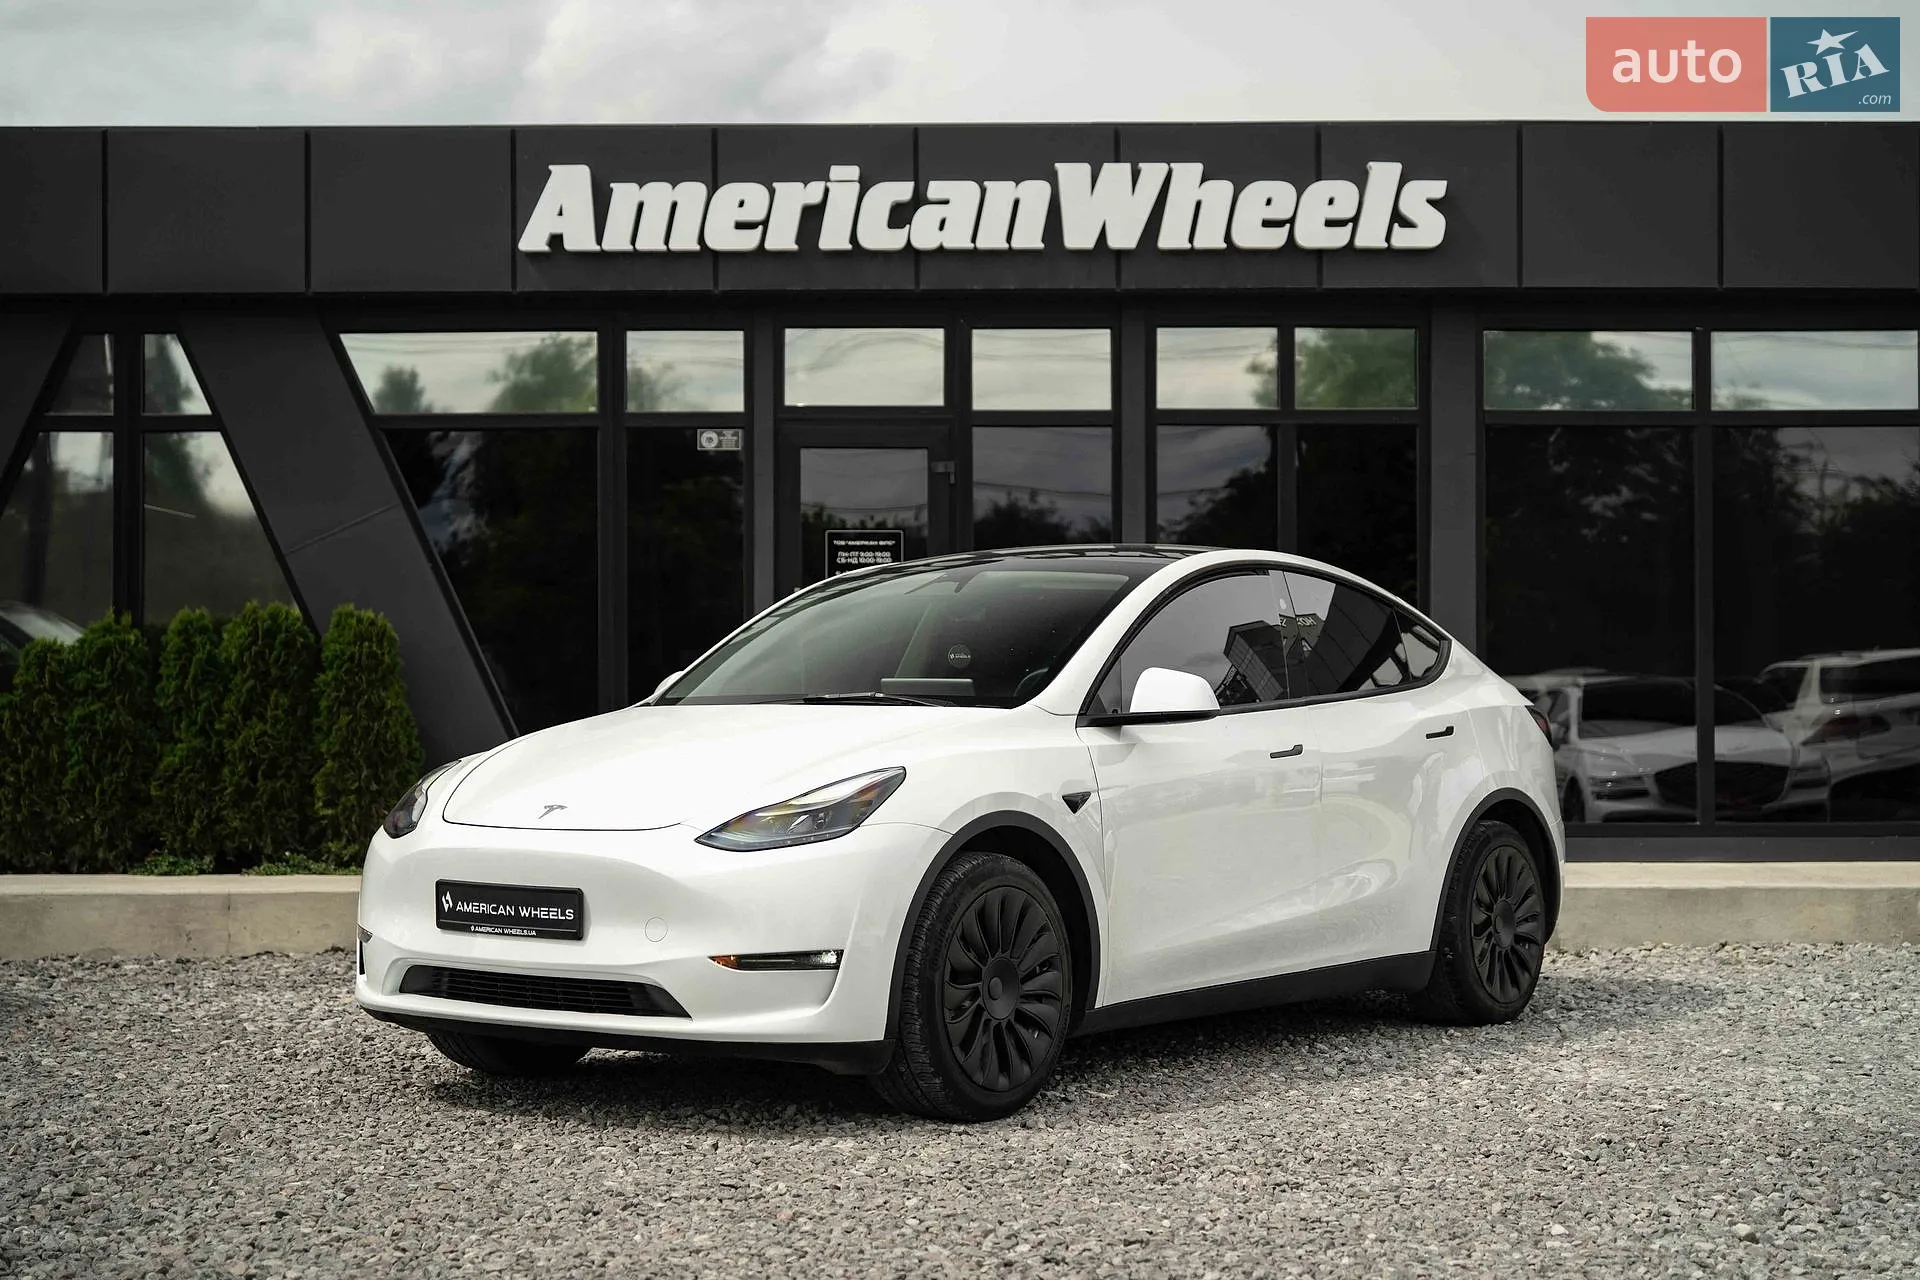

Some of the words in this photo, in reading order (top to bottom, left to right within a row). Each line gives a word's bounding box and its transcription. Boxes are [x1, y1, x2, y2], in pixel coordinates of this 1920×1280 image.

[517, 161, 1449, 252] AmericanWheels
[455, 900, 515, 916] AMERICAN
[518, 905, 574, 920] WHEELS
[475, 926, 502, 934] AMERICAN
[503, 928, 537, 936] WHEELS.UA
